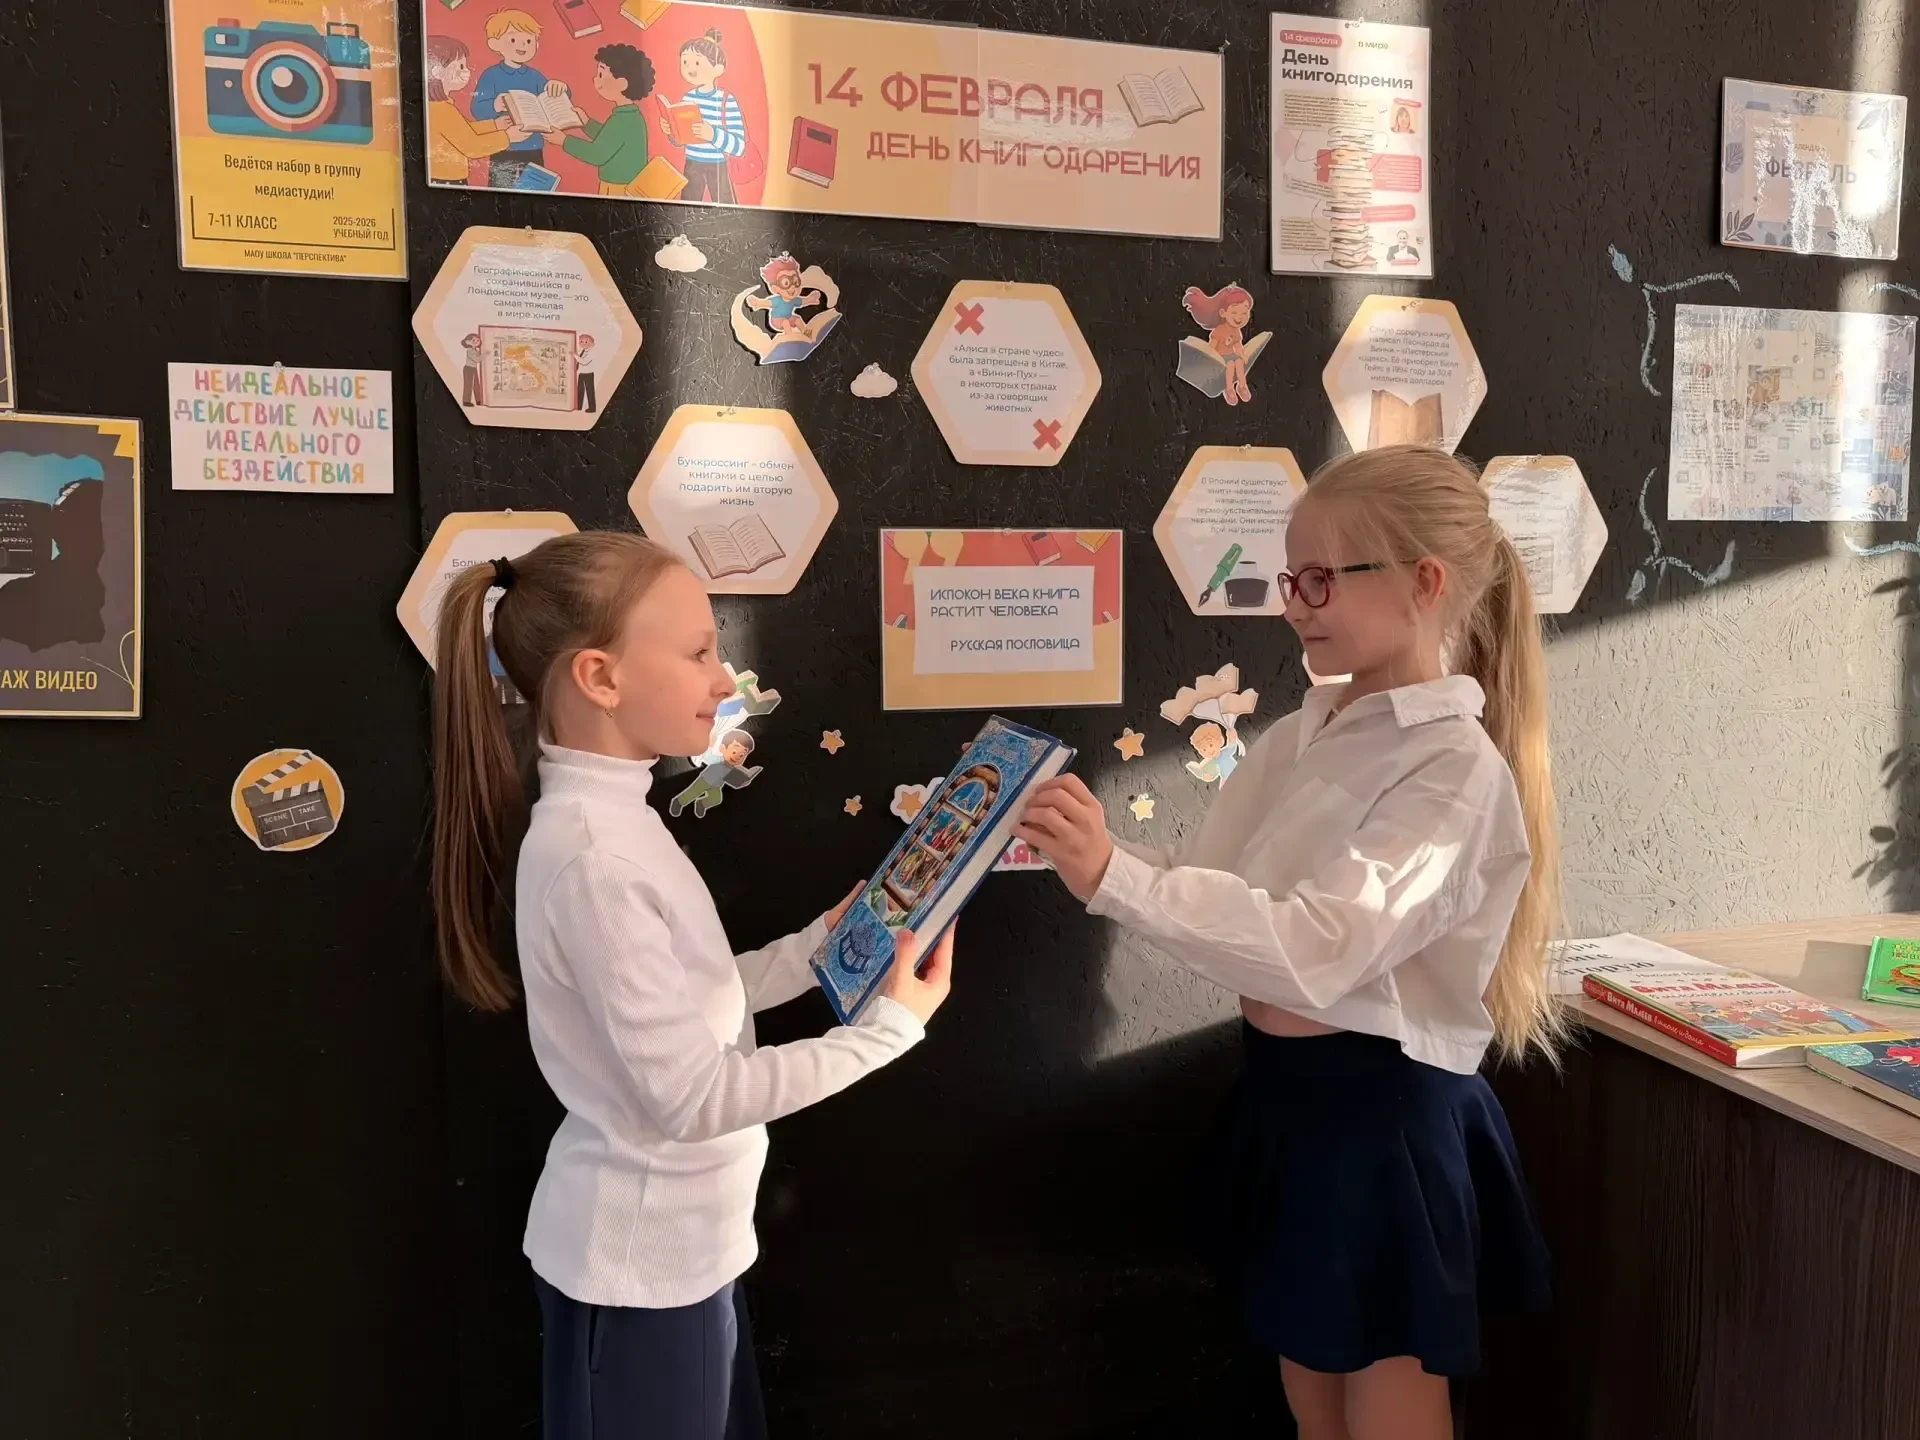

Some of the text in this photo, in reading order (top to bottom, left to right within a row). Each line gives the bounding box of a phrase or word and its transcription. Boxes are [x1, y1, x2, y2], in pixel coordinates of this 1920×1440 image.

[1284, 32, 1338, 46] 14 февраля
[1365, 42, 1388, 50] мире
[1282, 49, 1329, 65] День
[1282, 68, 1413, 90] книгодарения
[807, 63, 1104, 128] 14 ФЕВРАЛЯ
[867, 131, 1201, 180] ДЕНЬ КНИГОДАРЕНИЯ
[224, 154, 361, 178] Ведётся набор в группу
[255, 184, 334, 200] медиастудии!
[208, 213, 277, 230] 7-11 КЛАСС
[333, 216, 376, 227] 2025-2026
[334, 227, 389, 241] УЧЕБНЫЙ ГОД
[245, 249, 346, 263] МАОУ ШКОЛА "ПЕРСПЕКТИВА"
[473, 265, 582, 281] Географический атлас,
[486, 277, 562, 290] сохранившийся
[467, 286, 528, 298] Лондонском
[530, 292, 561, 301] музее,
[494, 299, 564, 310] самая тяжелая
[506, 311, 530, 319] мире
[1396, 328, 1428, 337] дорогую
[1430, 331, 1451, 339] книгу
[954, 344, 988, 354] «Алиса
[998, 347, 1031, 355] стране
[1033, 350, 1064, 359] чудес»
[949, 355, 973, 365] была
[976, 358, 1029, 367] запрещена
[1040, 360, 1068, 370] Китае,
[977, 368, 1037, 379] «Винни-Пух»
[1409, 368, 1426, 376] году
[194, 369, 368, 400] НЕИДЕАЛЬНОЕ
[968, 381, 1019, 391] некоторых
[1021, 383, 1057, 392] странах
[997, 394, 1048, 403] говорящих
[174, 395, 389, 430] ДЕЙСТВИЕ ЛУЧШЕ
[985, 405, 1032, 413] животных
[206, 429, 360, 456] ИДЕАЛЬНОГО
[203, 455, 364, 484] БЕЗДЕЙСТВИЯ
[677, 456, 748, 469] Буккроссинг
[759, 460, 794, 471] обмен
[689, 471, 737, 481] книгами
[748, 474, 784, 483] целью
[1241, 479, 1287, 487] существуют
[679, 483, 732, 494] подарить
[753, 487, 793, 496] вторую
[719, 498, 754, 506] жизнь
[931, 588, 1079, 600] ИСПОКОН ВЕКА КНИГА
[931, 605, 1058, 617] РАСТИТ ЧЕЛОВЕКА
[951, 638, 1080, 651] РУССКАЯ ПОСЛОВИЦА
[35, 670, 98, 691] ВИДЕО
[298, 805, 316, 815] TAKE
[264, 813, 288, 824] SCENE
[1607, 992, 1625, 1009] Витя
[1626, 1000, 1652, 1022] Малеев
